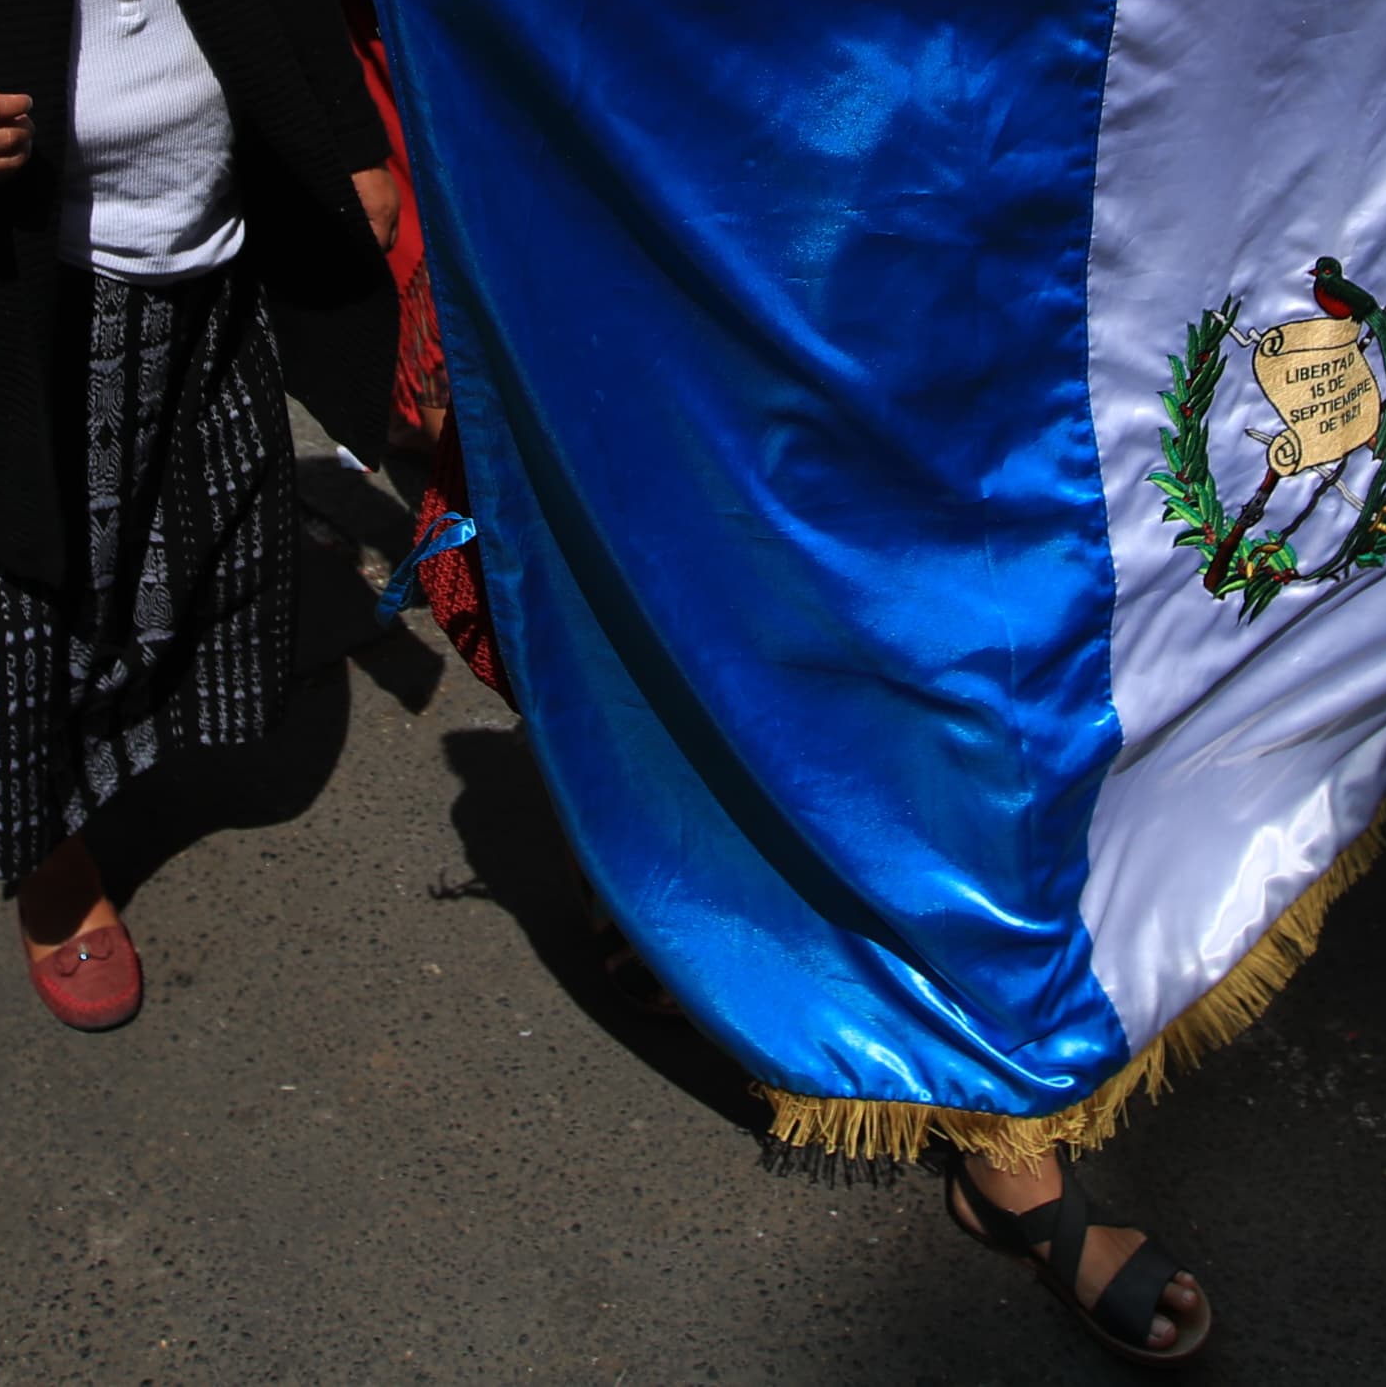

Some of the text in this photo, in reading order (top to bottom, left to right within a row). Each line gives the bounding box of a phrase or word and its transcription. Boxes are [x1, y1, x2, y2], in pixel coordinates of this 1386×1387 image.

[1286, 353, 1355, 384] LIBERTAD
[1290, 378, 1372, 423] SEPTIEMBRE
[1310, 374, 1346, 399] 15 DE
[1319, 403, 1361, 434] DE 1821
